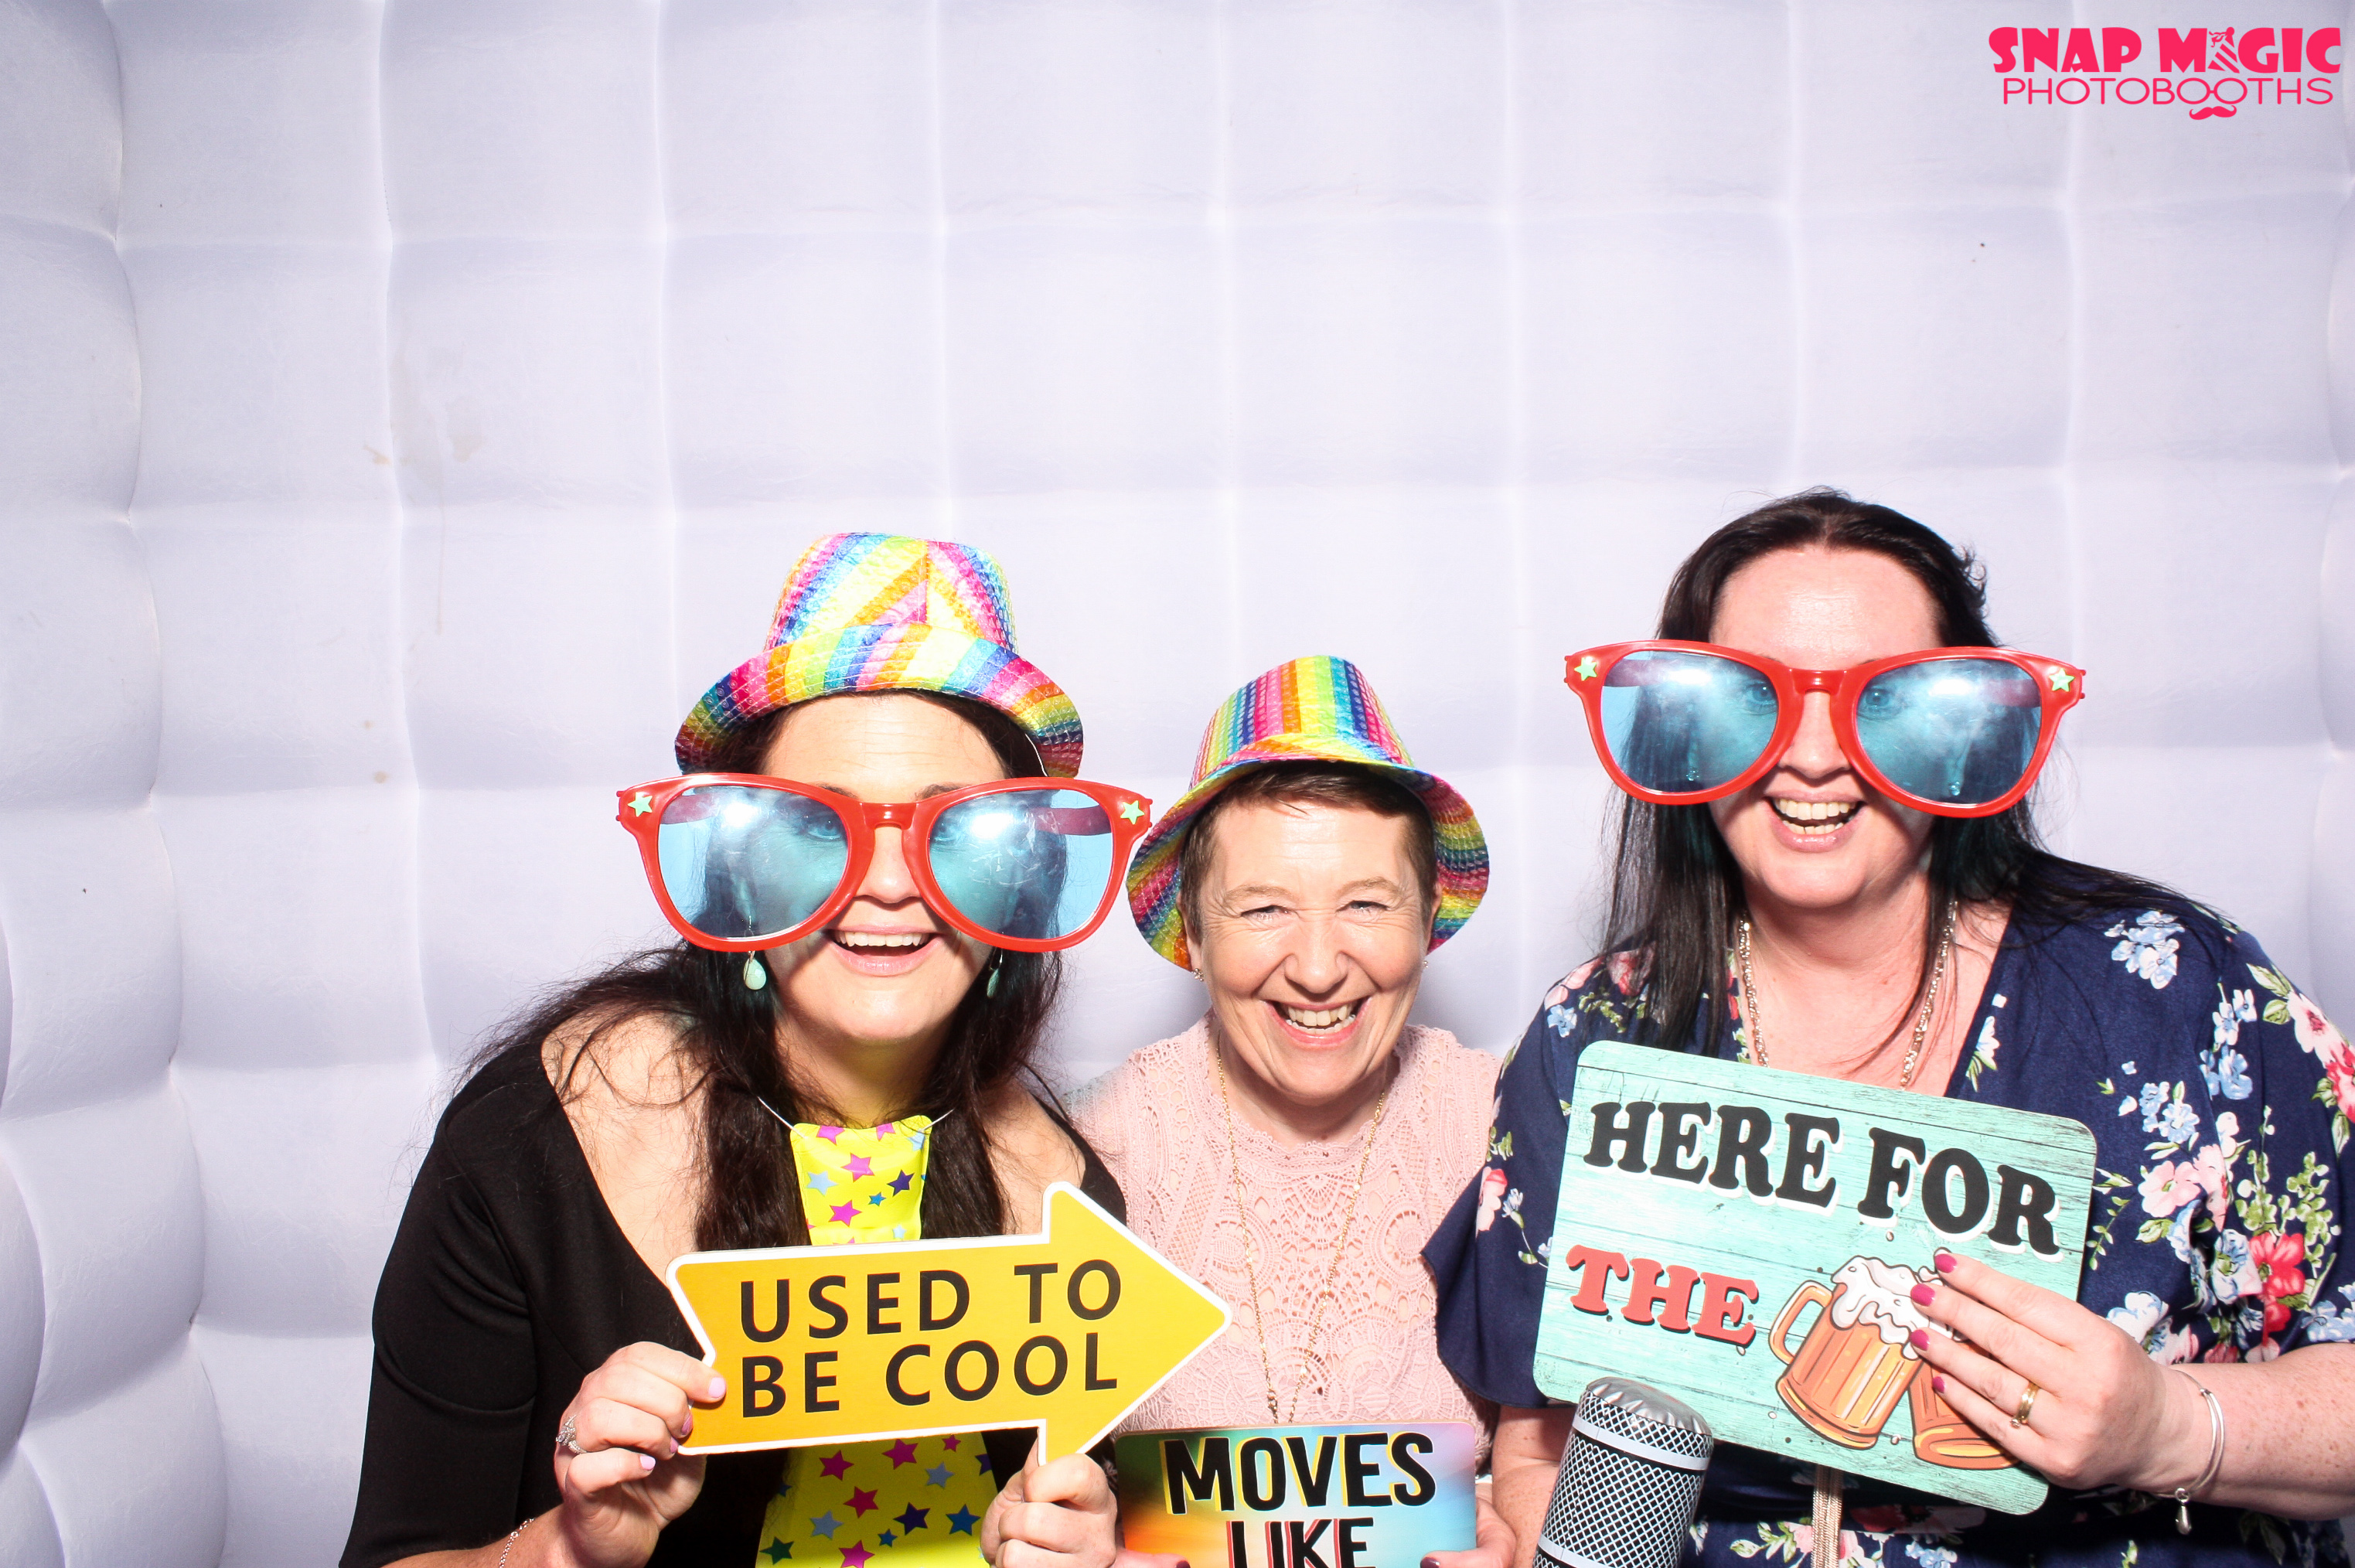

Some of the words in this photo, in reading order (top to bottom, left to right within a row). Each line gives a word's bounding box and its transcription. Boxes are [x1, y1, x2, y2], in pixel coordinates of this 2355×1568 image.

[1583, 1101, 1842, 1212] HERE
[1858, 1127, 2063, 1260] FOR
[740, 1270, 970, 1343] USED
[1014, 1260, 1121, 1324] TO
[1566, 1245, 1759, 1346] THE
[742, 1351, 840, 1418] BE
[885, 1332, 1117, 1406] COOL
[1161, 1432, 1436, 1514] MOVES
[1226, 1517, 1374, 1568] LIKE
